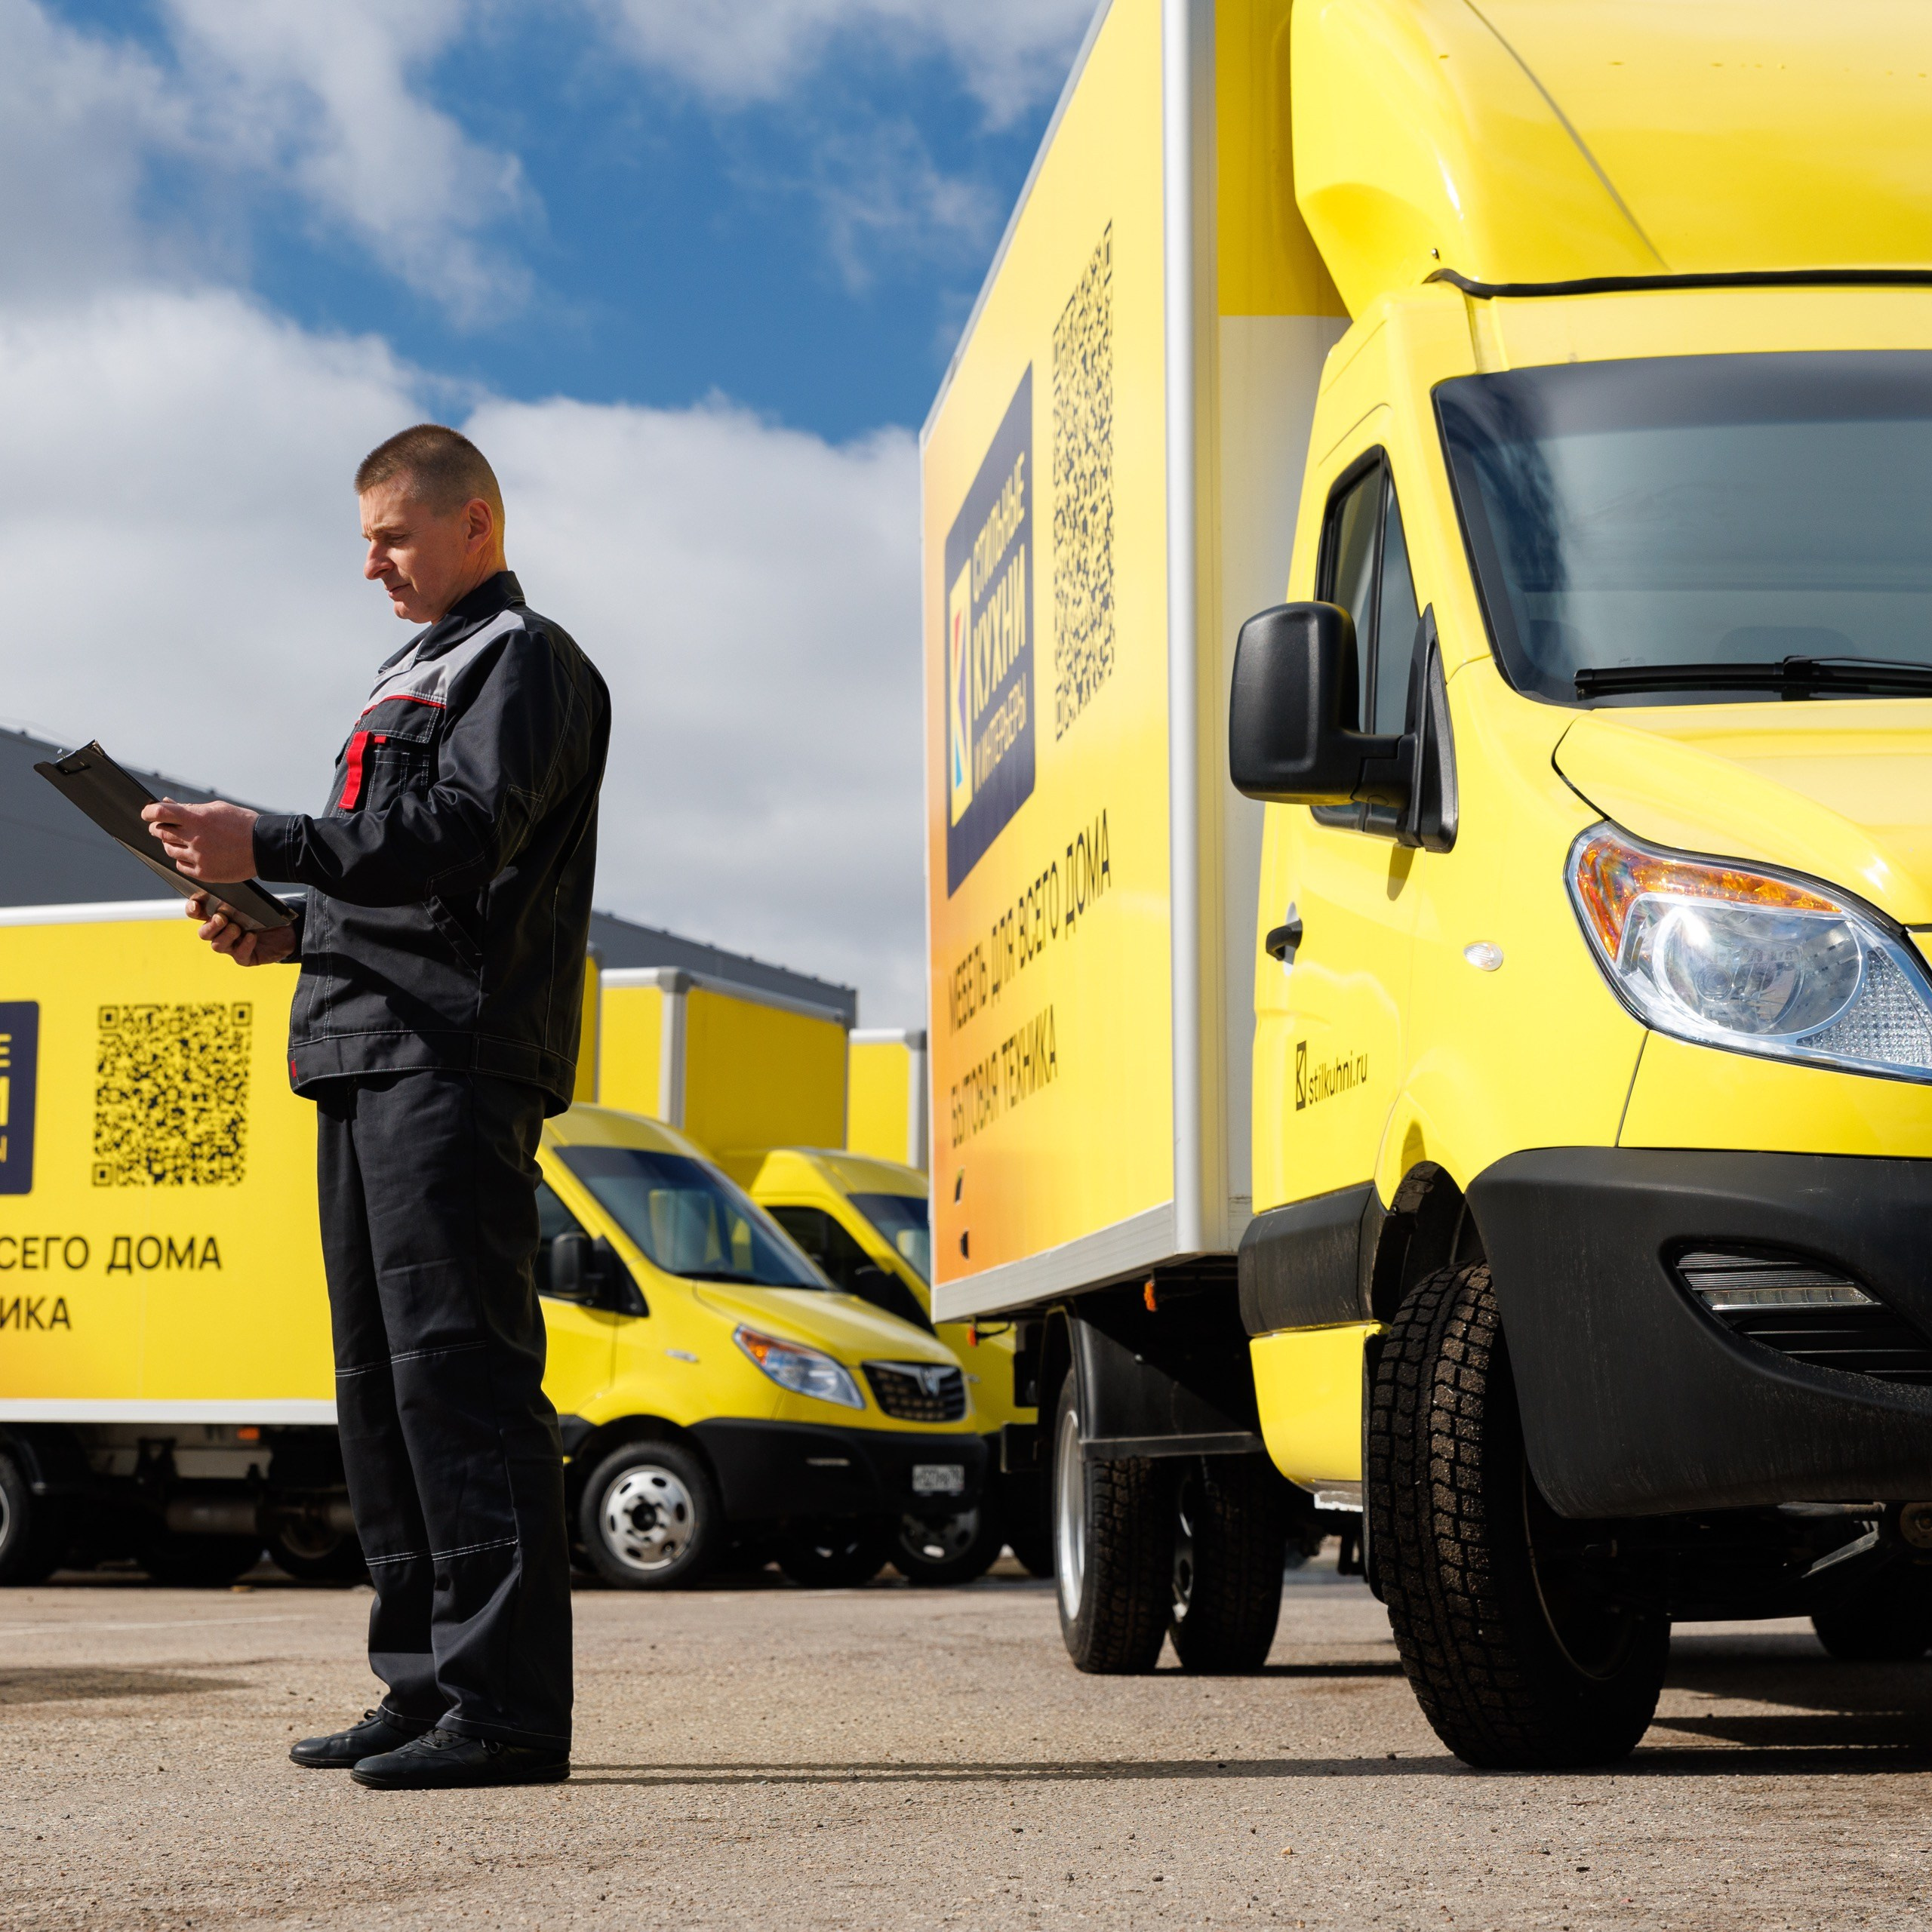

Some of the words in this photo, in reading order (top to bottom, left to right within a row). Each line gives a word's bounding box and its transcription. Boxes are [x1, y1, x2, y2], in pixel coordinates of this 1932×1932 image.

[973, 451, 1025, 603] СТИЛЬНЫЕ
[973, 543, 1026, 721] КУХНИ
[974, 672, 1027, 793] ИНТЕРЬЕРЫ
[948, 940, 987, 1036] МЕБЕЛЬ
[991, 908, 1015, 1008] ДЛЯ
[1019, 860, 1059, 969] ВСЕГО
[1066, 808, 1111, 940] ДОМА
[951, 1051, 1000, 1149] БЫТОВАЯ
[1002, 1004, 1058, 1112] ТЕХНИКА
[1309, 1050, 1367, 1105] stilkuhni.ru
[106, 1235, 222, 1275] ДОМА
